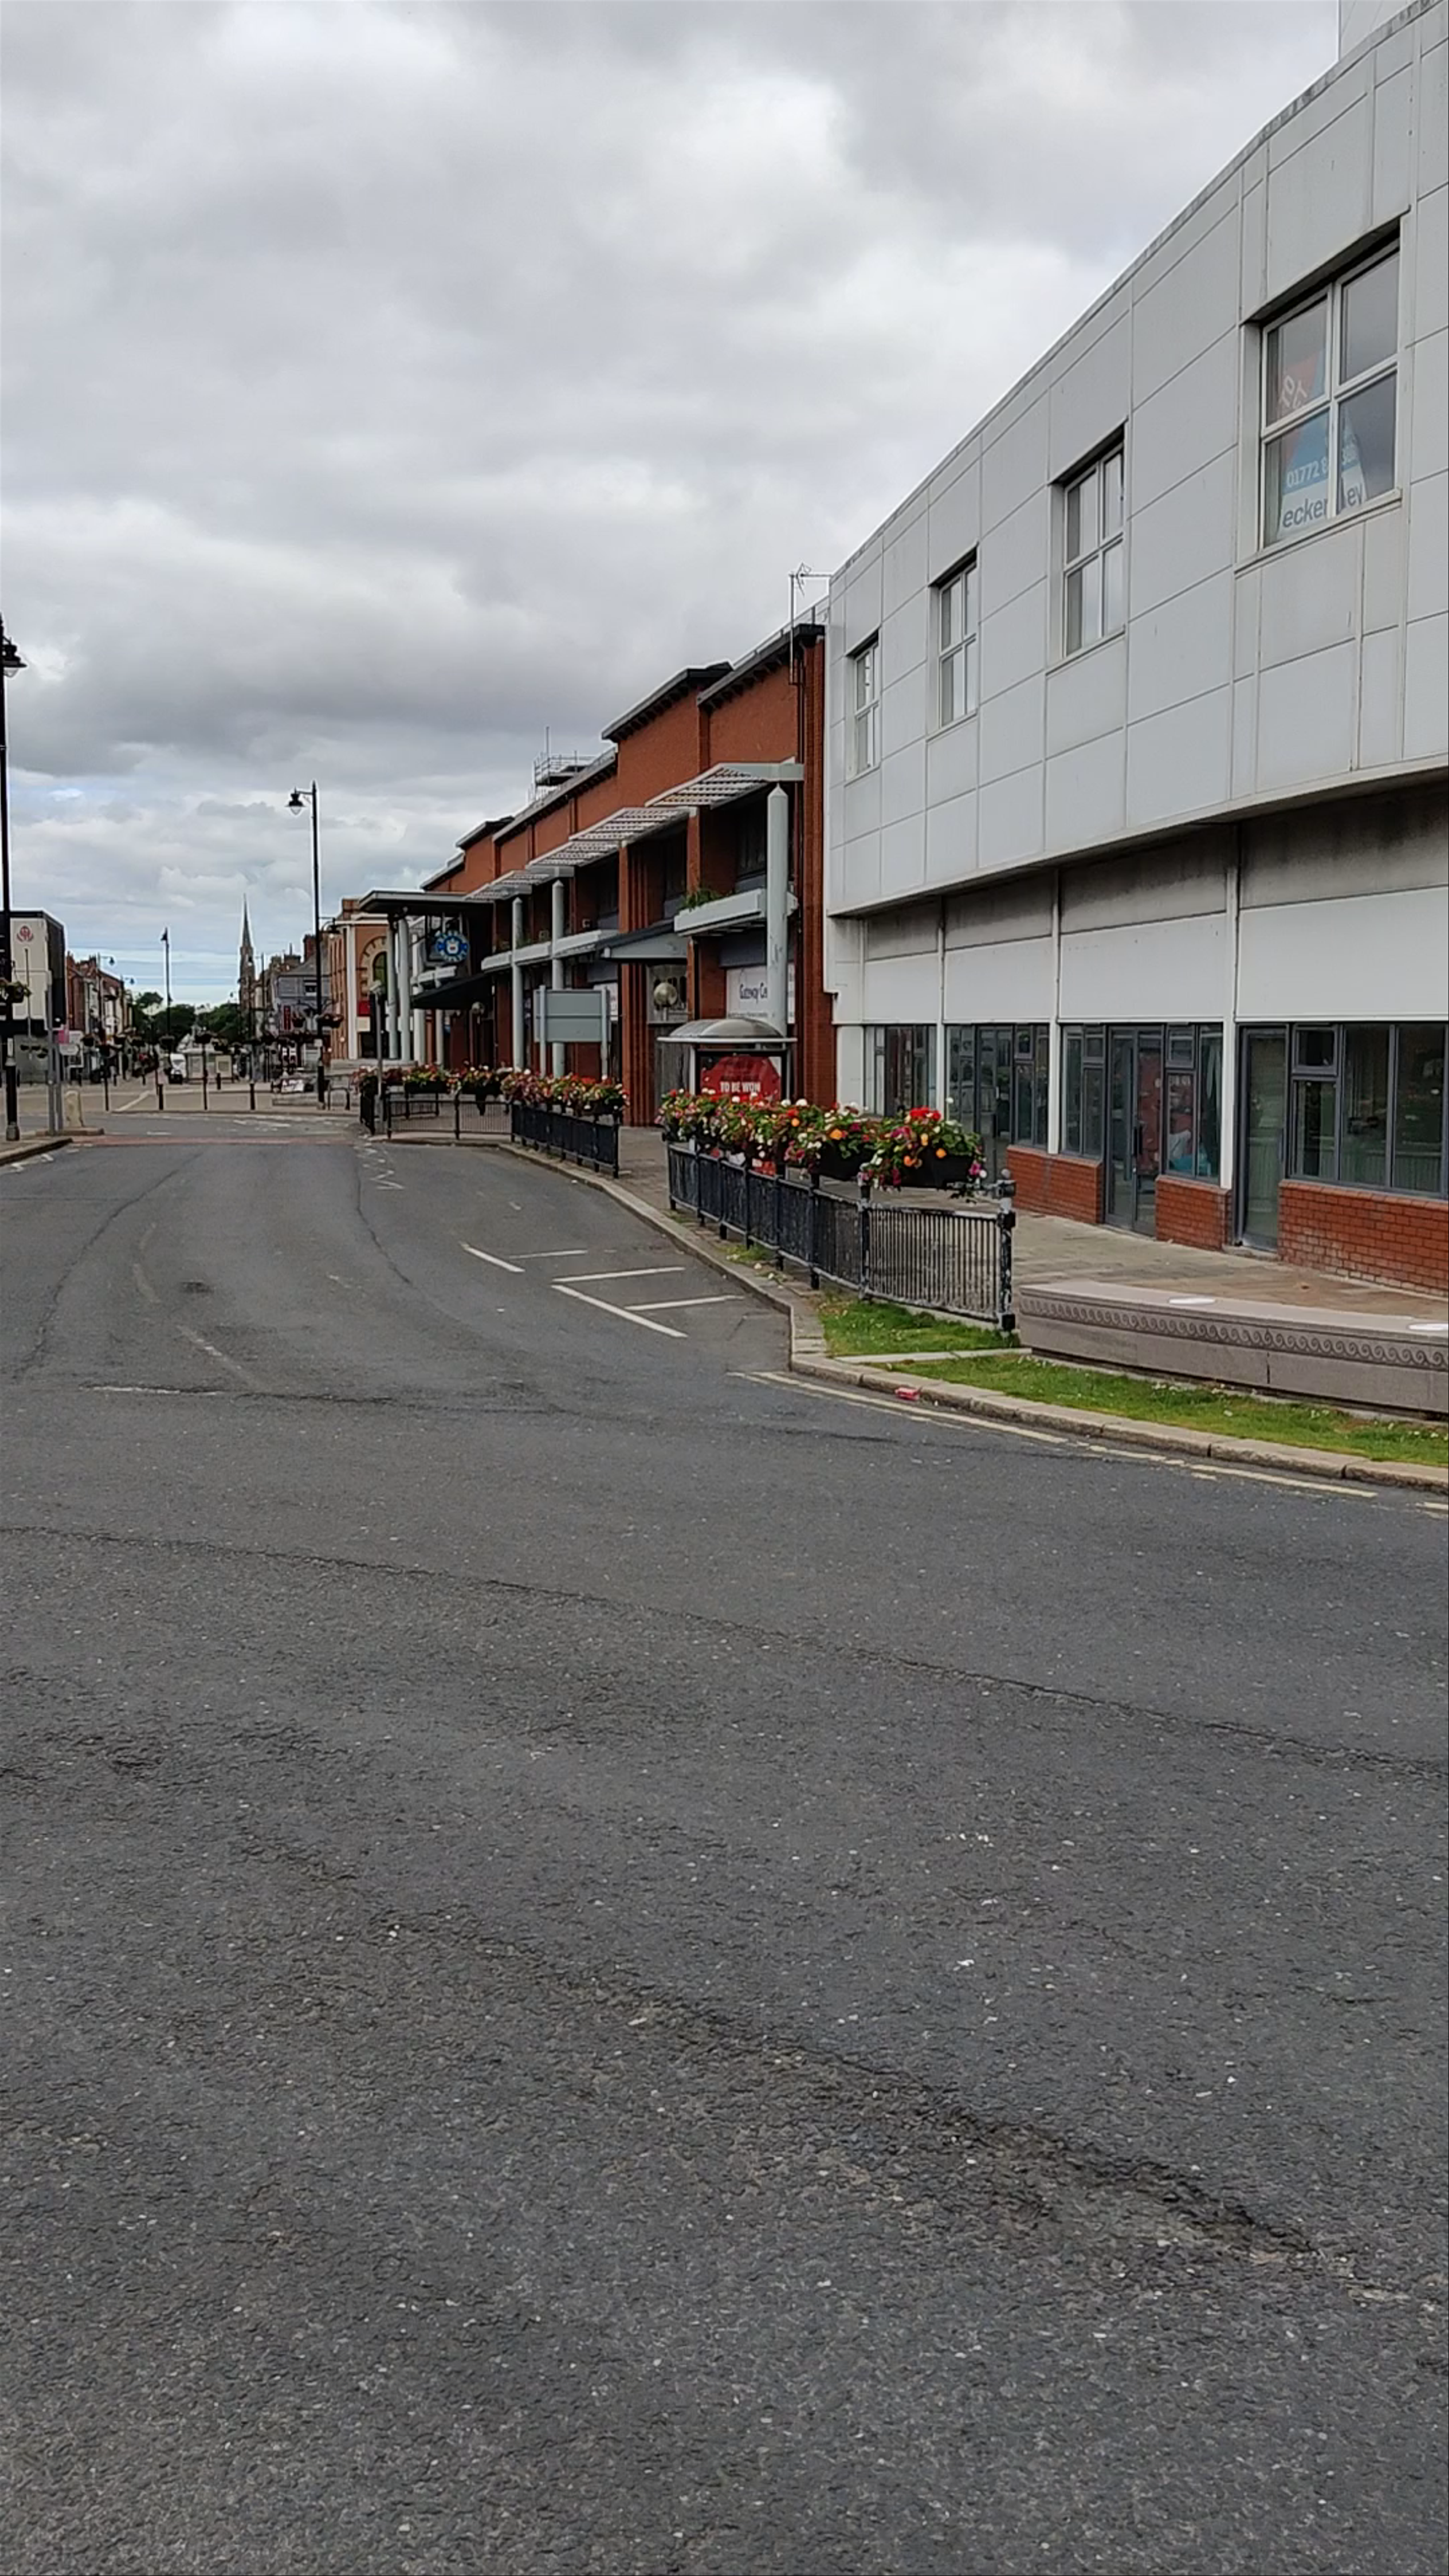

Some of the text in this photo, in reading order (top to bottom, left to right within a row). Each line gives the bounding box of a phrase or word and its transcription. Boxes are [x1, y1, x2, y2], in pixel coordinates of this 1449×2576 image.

[1286, 460, 1320, 488] 01772
[720, 1081, 761, 1092] TO BE WON
